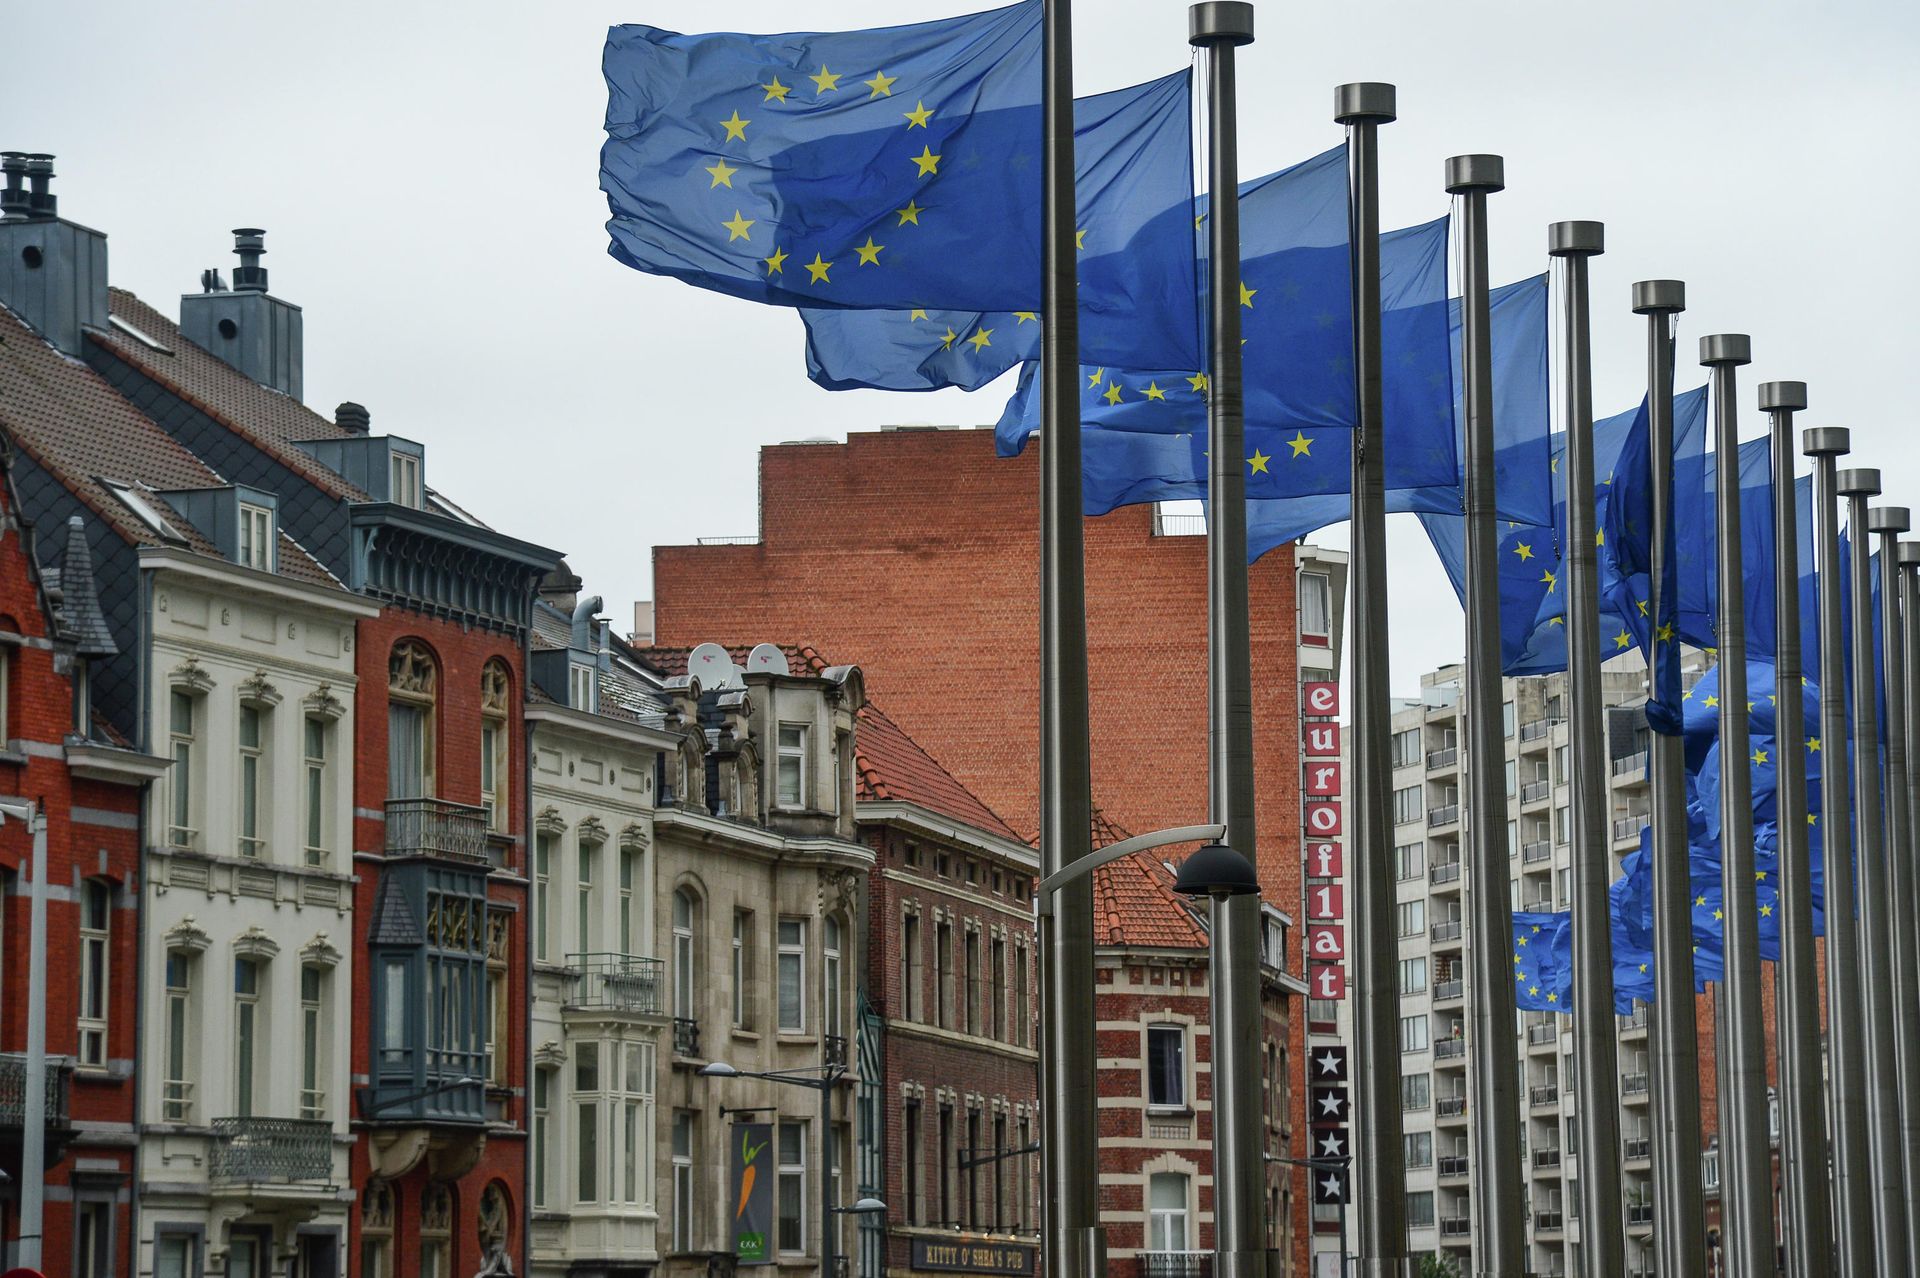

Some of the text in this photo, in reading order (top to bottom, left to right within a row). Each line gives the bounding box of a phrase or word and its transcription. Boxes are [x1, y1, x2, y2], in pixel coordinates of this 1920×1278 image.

[1310, 687, 1341, 997] euroflat
[926, 1245, 957, 1265] KITTY
[972, 1248, 1003, 1268] SHEA'S
[1007, 1251, 1023, 1269] PUB
